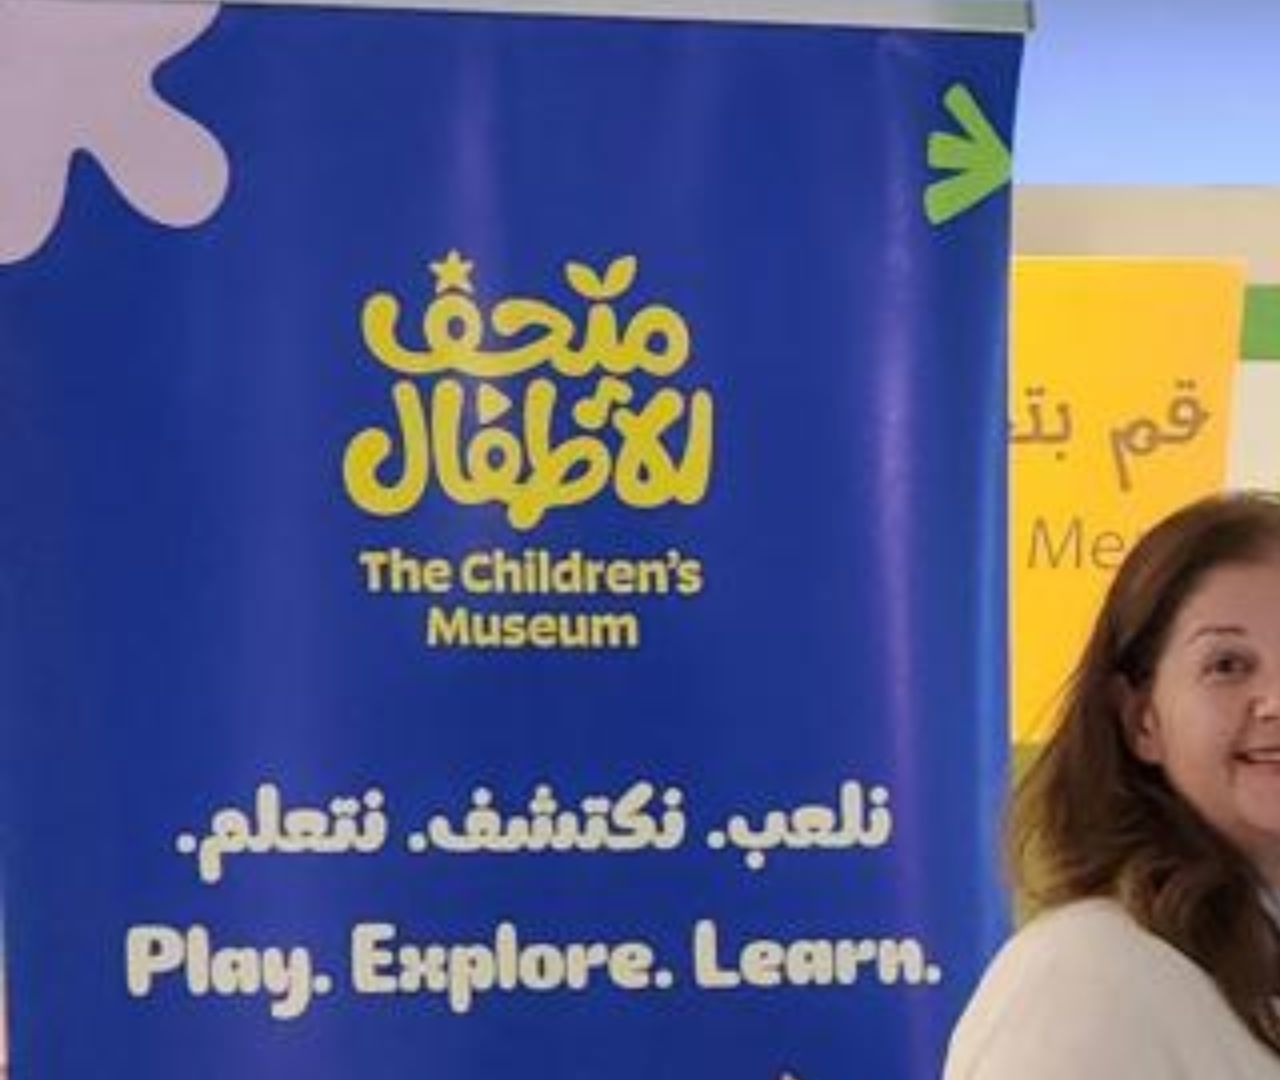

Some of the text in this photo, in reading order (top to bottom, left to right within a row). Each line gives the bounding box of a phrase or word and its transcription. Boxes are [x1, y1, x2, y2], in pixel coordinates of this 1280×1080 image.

[361, 250, 690, 377] متحف
[1008, 379, 1209, 491] قم بت
[359, 549, 703, 593] The Children's
[1027, 517, 1126, 569] Me
[427, 607, 640, 648] Museum
[177, 781, 892, 884] نلعب. نكتشف. نتعلم.
[124, 919, 942, 1018] Play. Explore. Learn.
